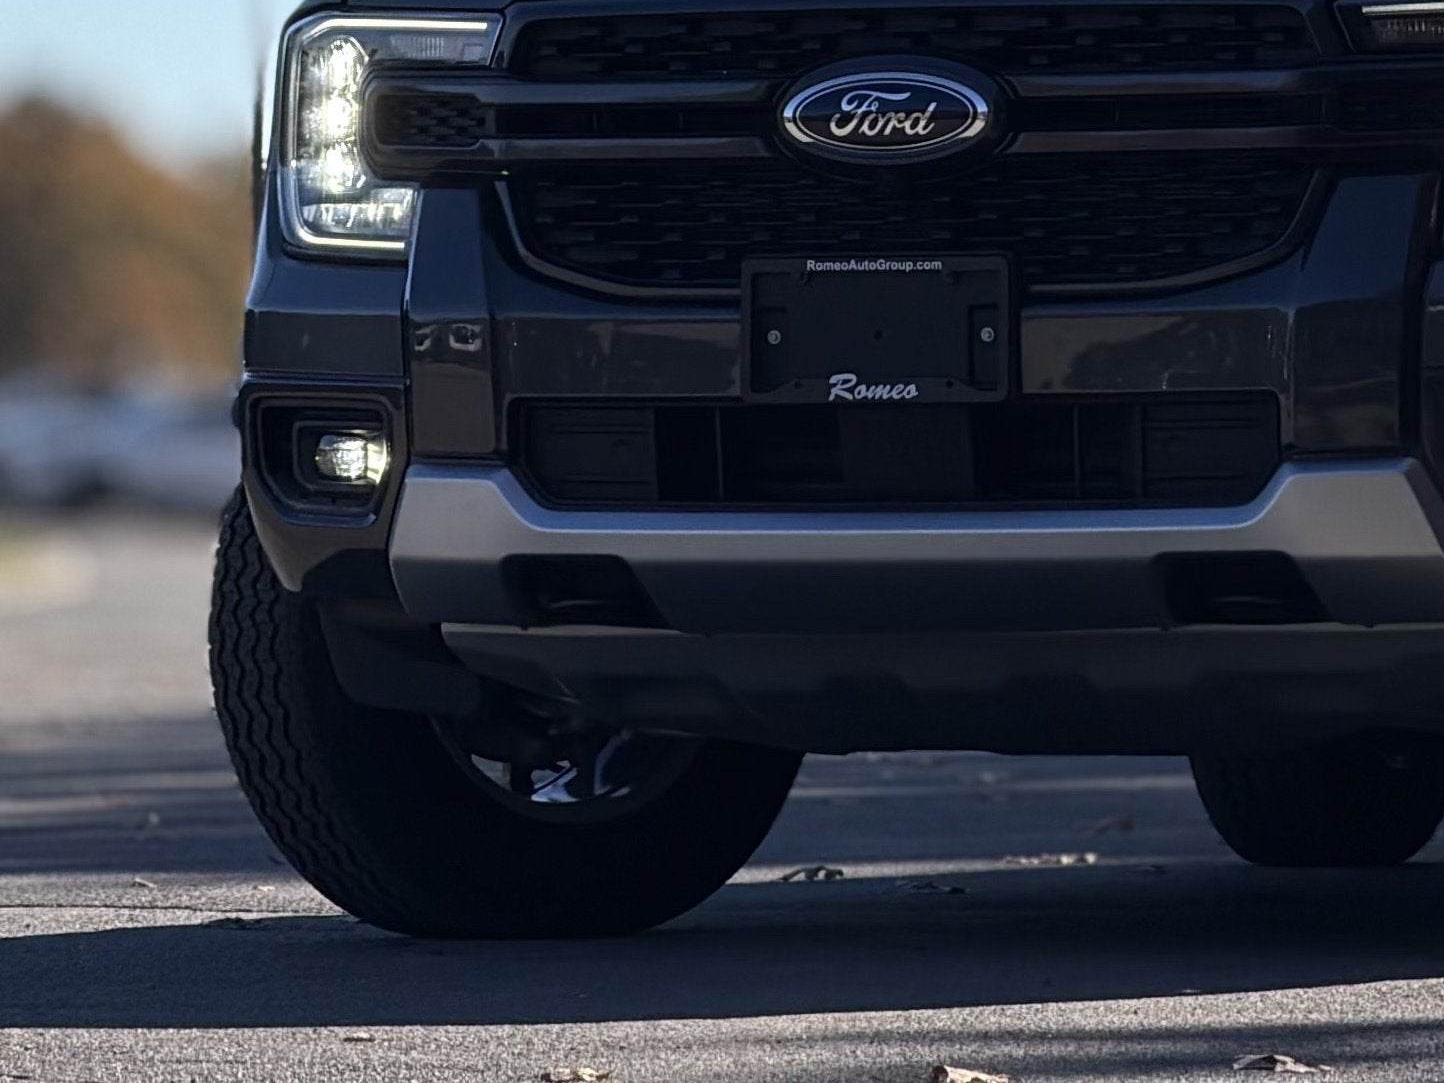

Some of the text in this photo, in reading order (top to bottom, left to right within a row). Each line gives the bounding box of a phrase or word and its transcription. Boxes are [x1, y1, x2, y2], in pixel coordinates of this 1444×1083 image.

[829, 89, 938, 137] Ford
[806, 259, 943, 273] RomeoAutoGroup.com
[828, 373, 919, 402] Romeo
